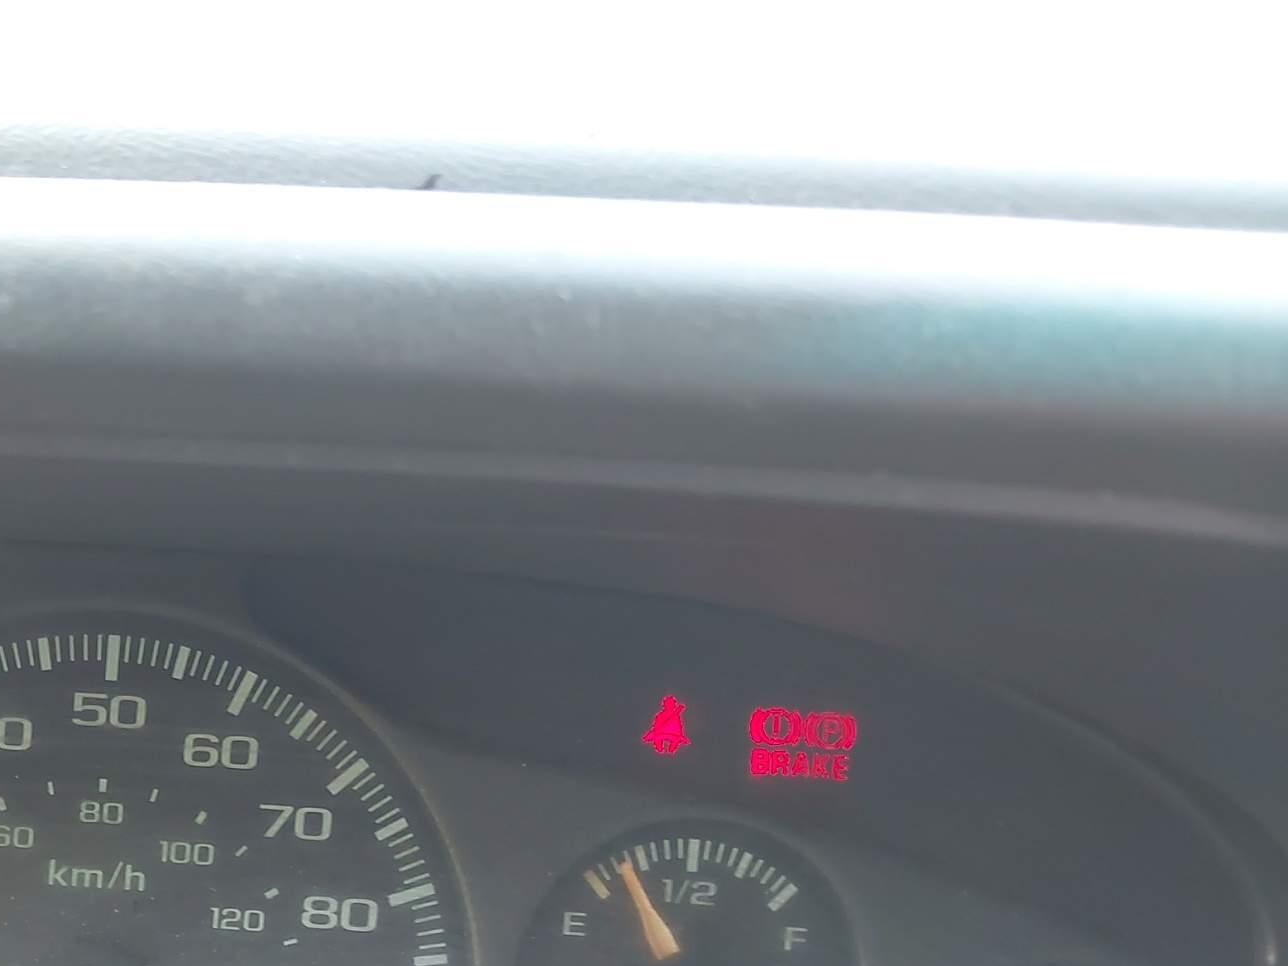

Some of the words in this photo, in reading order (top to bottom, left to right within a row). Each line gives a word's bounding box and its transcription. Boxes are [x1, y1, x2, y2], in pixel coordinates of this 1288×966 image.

[71, 691, 147, 729] 50
[183, 733, 259, 769] 60
[748, 748, 850, 781] BRAKE
[78, 801, 124, 824] 80
[259, 804, 333, 841] 70
[159, 840, 214, 865] 100
[48, 859, 146, 891] km/h
[662, 879, 718, 906] 1/2
[210, 907, 264, 932] 120
[300, 896, 378, 932] 80
[562, 911, 588, 937] E
[783, 926, 809, 951] F
